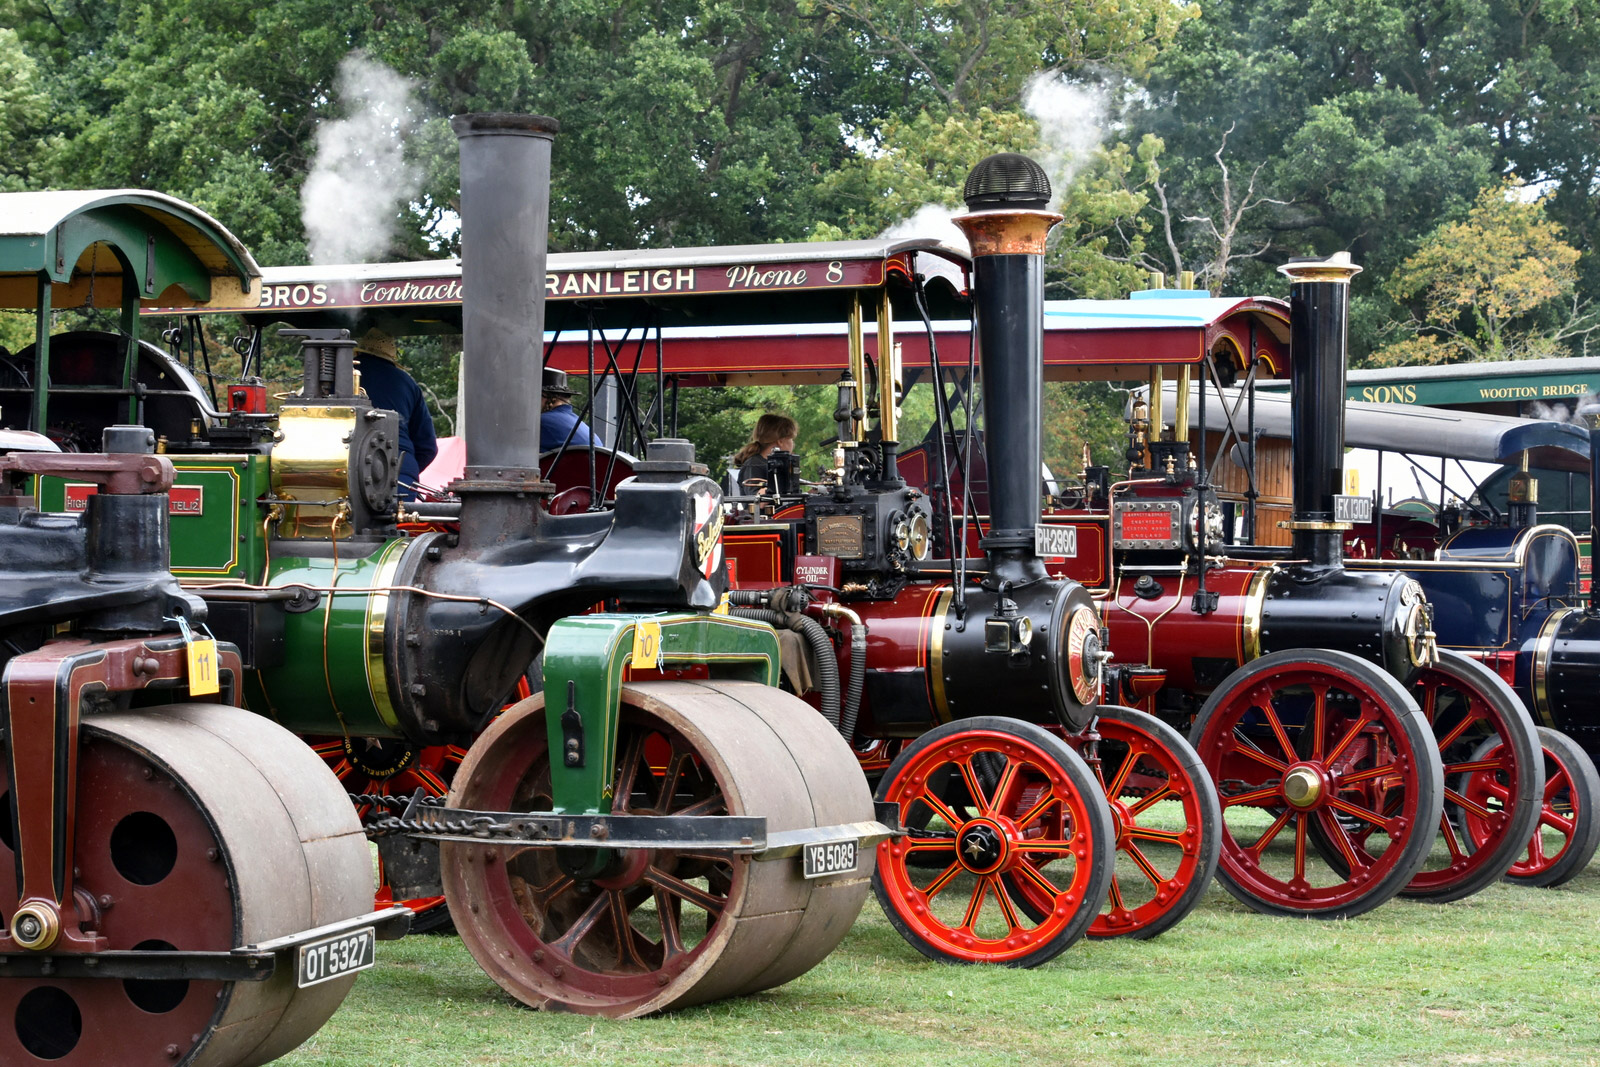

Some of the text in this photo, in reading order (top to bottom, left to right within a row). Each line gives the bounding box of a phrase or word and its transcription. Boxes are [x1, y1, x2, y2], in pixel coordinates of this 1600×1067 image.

[725, 265, 807, 288] Phone
[825, 260, 843, 283] 8
[1362, 384, 1417, 404] SONS
[1479, 383, 1588, 399] WOOTTON BRIDGE
[795, 566, 829, 575] CYLINDER
[805, 574, 819, 583] OIL
[640, 633, 653, 658] 10
[197, 652, 211, 681] 11
